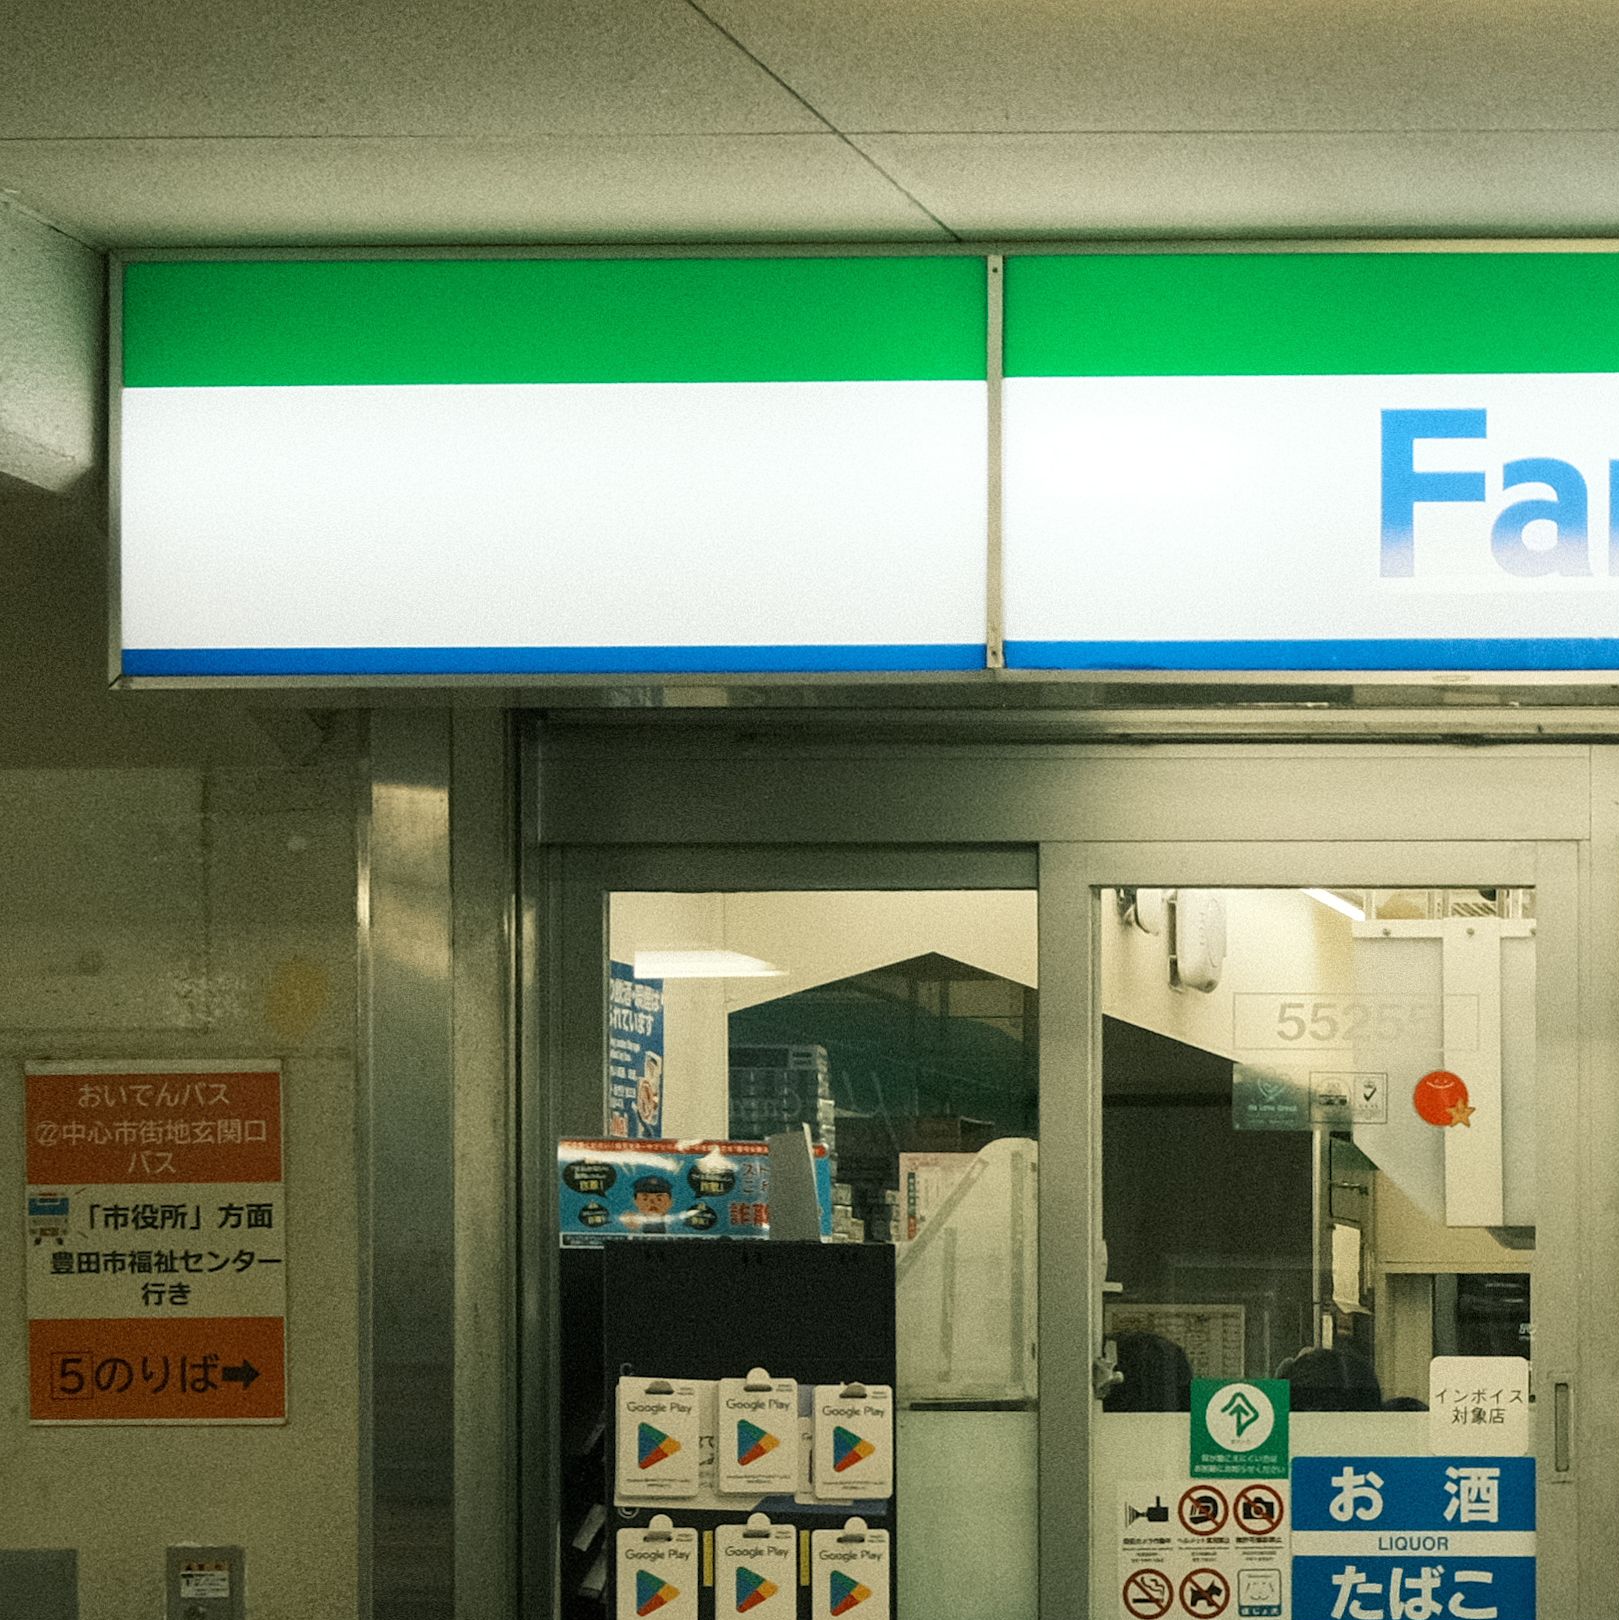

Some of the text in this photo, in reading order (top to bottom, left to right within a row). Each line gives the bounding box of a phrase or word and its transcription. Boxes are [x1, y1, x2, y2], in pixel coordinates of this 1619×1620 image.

[77, 1082, 230, 1108] おいでんバス
[127, 1150, 176, 1174] バス
[88, 1203, 273, 1230] 「市役所」 方面
[50, 1250, 282, 1275] 豊田市福祉センター
[141, 1282, 192, 1306] 行き
[59, 1354, 218, 1395] 5のりば
[725, 1397, 791, 1411] Google Play
[1434, 1387, 1524, 1404] インボイス
[626, 1401, 692, 1416] Google Play
[822, 1404, 886, 1418] Google Play
[1451, 1407, 1505, 1425] 対象店
[724, 1545, 789, 1559] Google Play
[1377, 1536, 1449, 1552] LIQUOR
[625, 1548, 692, 1562] Google Play
[818, 1549, 884, 1562] Google Play
